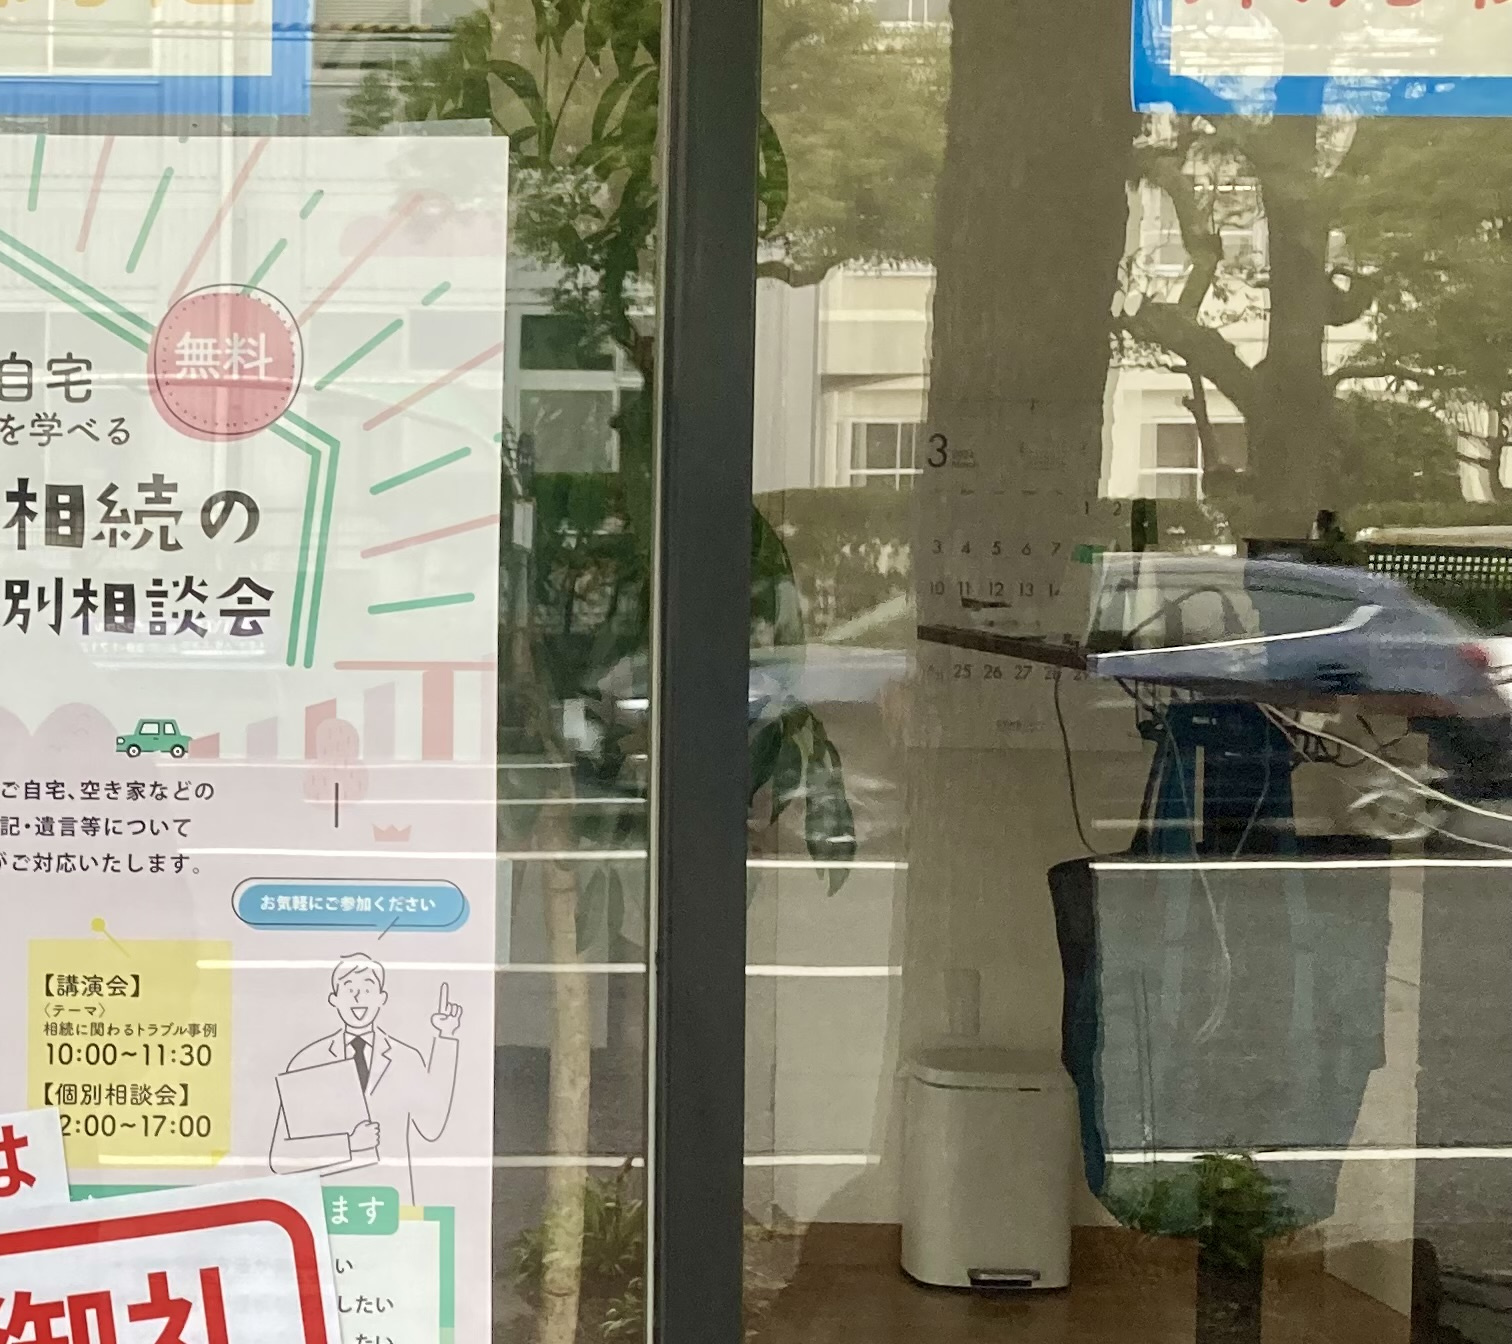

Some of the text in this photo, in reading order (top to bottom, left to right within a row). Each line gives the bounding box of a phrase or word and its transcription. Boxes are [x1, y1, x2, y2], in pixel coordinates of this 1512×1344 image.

[175, 331, 273, 381] 無料
[927, 432, 948, 468] 3
[961, 541, 970, 554] 4
[992, 541, 1002, 555] 5
[1022, 541, 1032, 555] 6
[1051, 541, 1061, 555] 7
[989, 581, 1004, 597] 12
[1020, 582, 1034, 597] 13
[953, 663, 972, 678] 25
[983, 664, 1003, 679] 26
[1014, 665, 1033, 680] 27
[260, 895, 437, 912] お気軽にご参加ください
[45, 973, 140, 998] 【講演会】
[43, 1022, 218, 1038] 相続に関わるトラブル事例
[47, 1042, 212, 1066] 10:00～11:30
[44, 1082, 189, 1106] 【個別相談会】
[60, 1114, 212, 1138] 2:00～17:00
[331, 1195, 385, 1225] ます
[338, 1294, 394, 1314] したい
